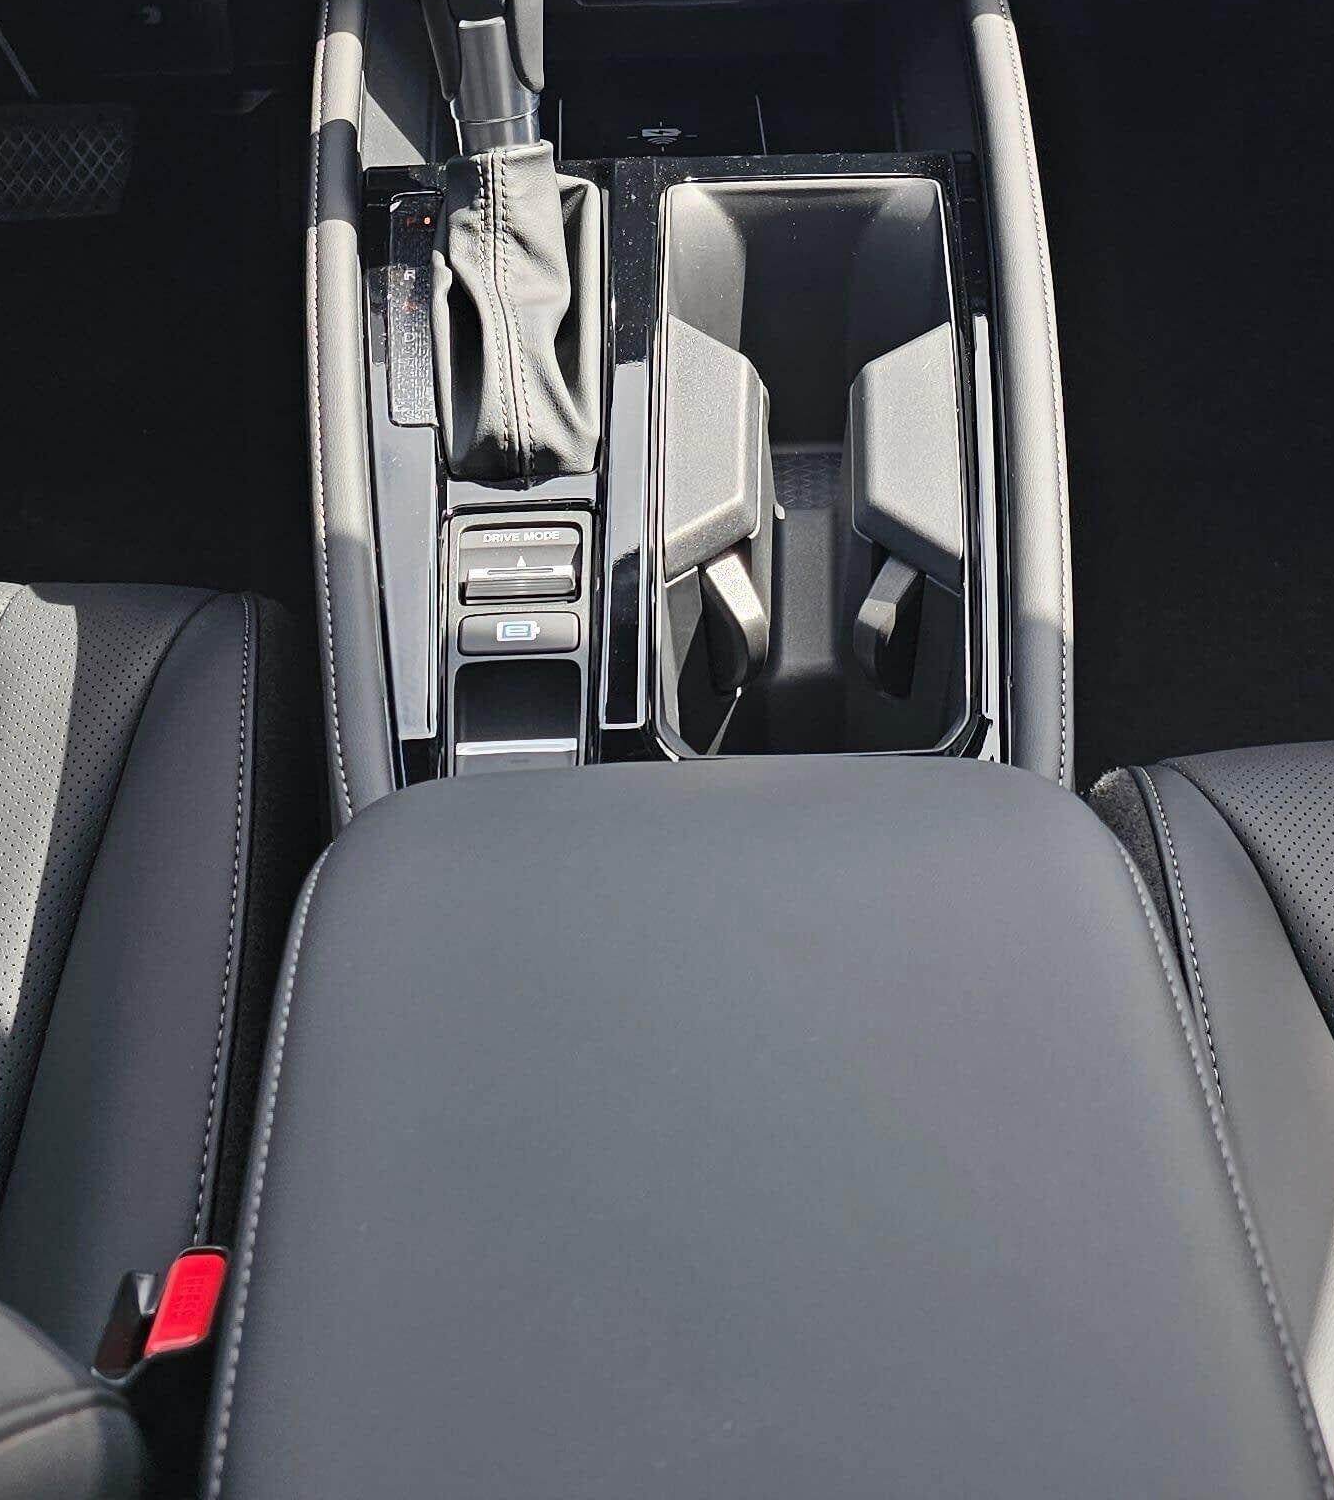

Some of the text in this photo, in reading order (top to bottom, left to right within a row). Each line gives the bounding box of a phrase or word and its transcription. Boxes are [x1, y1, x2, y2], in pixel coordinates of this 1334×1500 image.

[404, 270, 416, 280] R
[404, 332, 415, 342] D
[483, 530, 560, 543] DRIVE MODE
